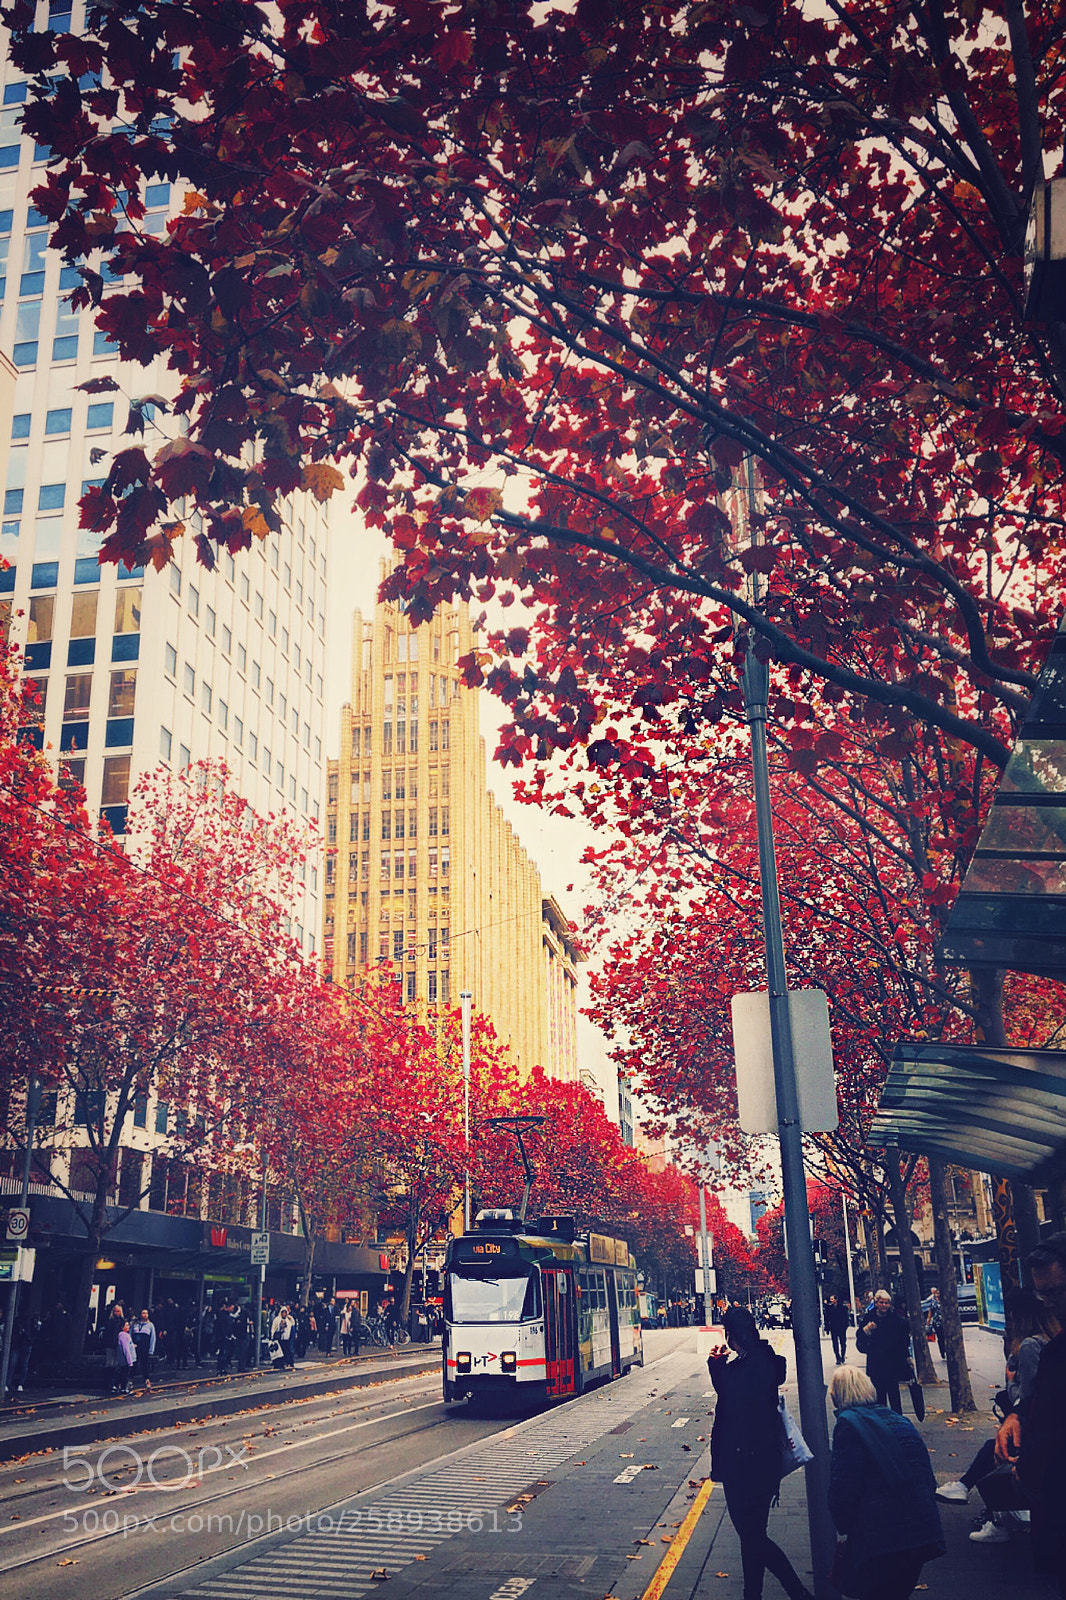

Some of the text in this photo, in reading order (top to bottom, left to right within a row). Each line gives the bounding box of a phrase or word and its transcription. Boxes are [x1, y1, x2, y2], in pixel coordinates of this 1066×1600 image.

[12, 1218, 25, 1229] 30
[550, 1219, 558, 1231] 1
[485, 1243, 501, 1254] City
